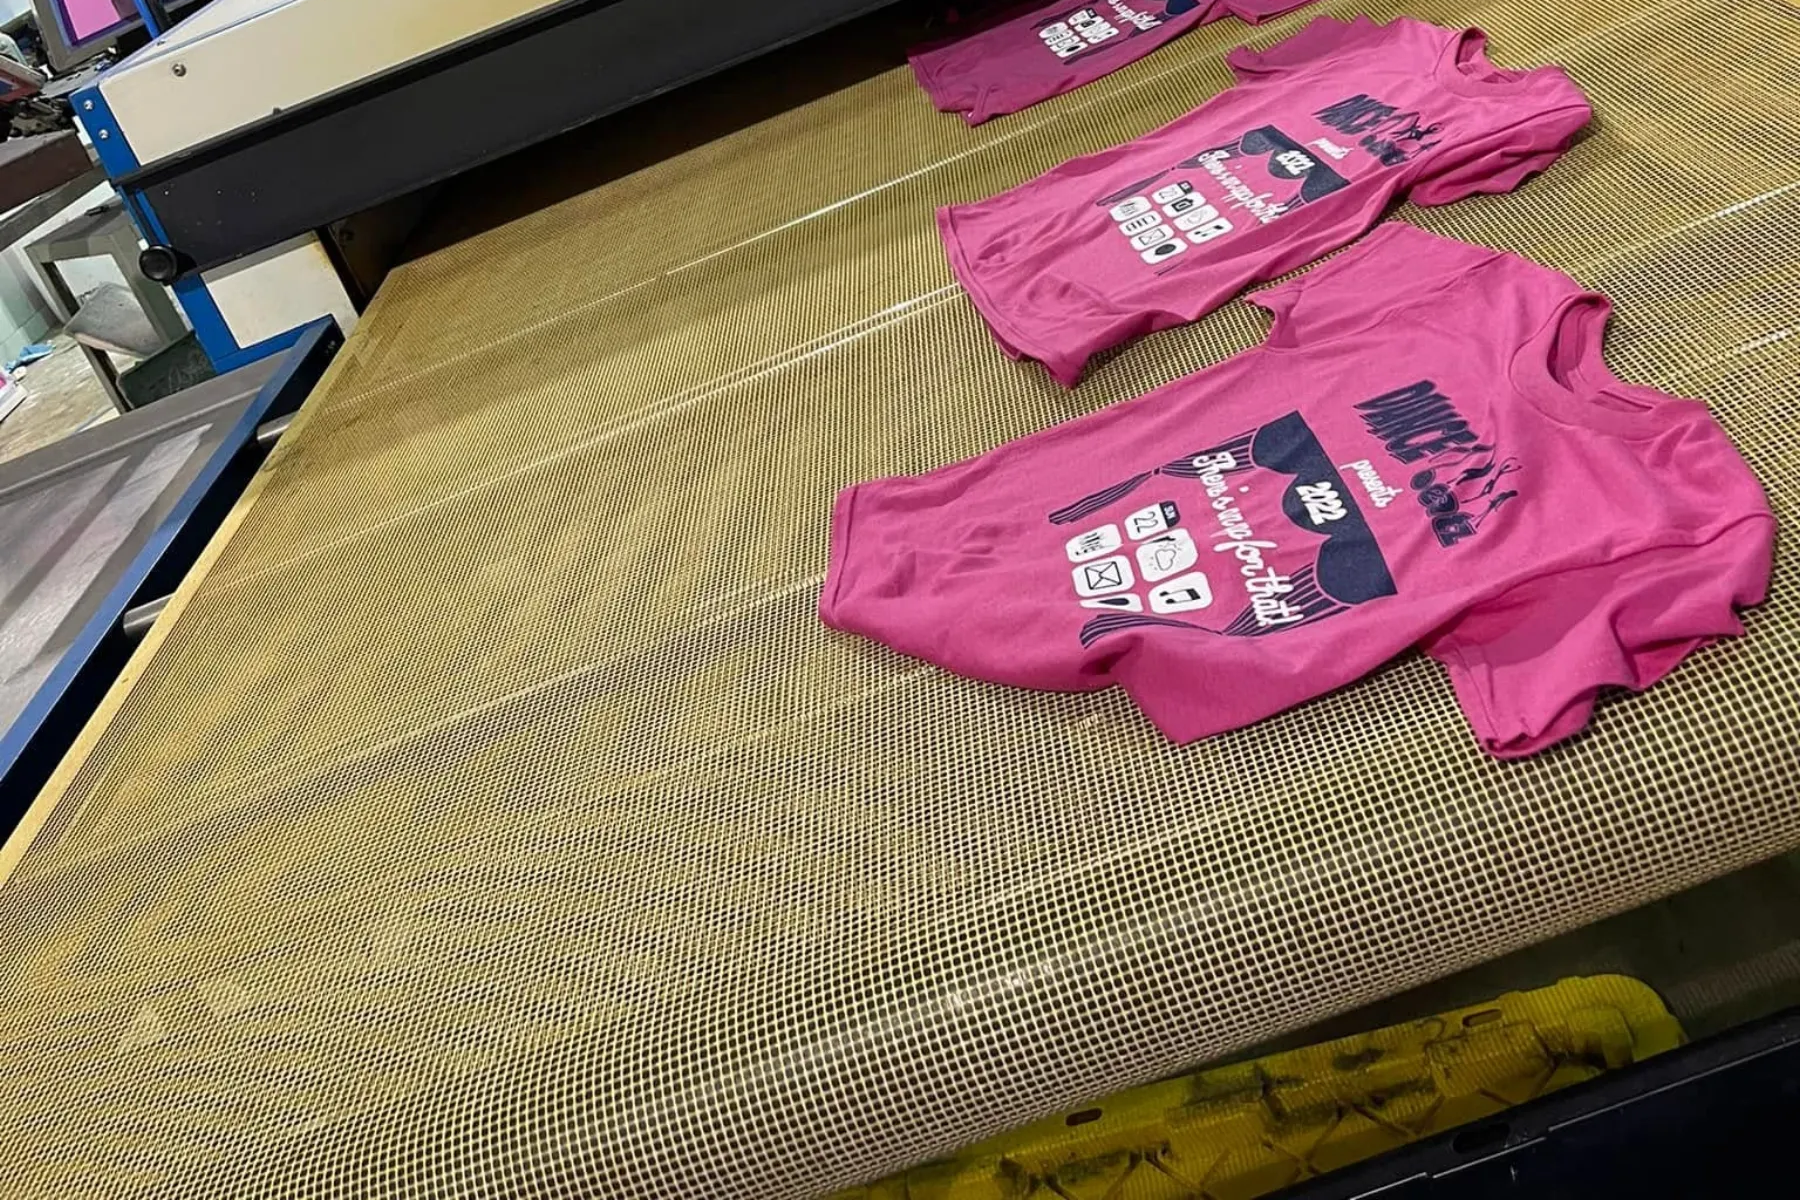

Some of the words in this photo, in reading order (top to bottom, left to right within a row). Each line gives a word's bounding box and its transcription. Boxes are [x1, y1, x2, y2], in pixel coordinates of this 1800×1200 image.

[1353, 379, 1479, 465] DANCE
[1296, 481, 1348, 526] 2022
[1339, 459, 1404, 509] presents
[1133, 510, 1159, 534] 22
[1213, 540, 1279, 577] for
[1245, 566, 1304, 627] that!
